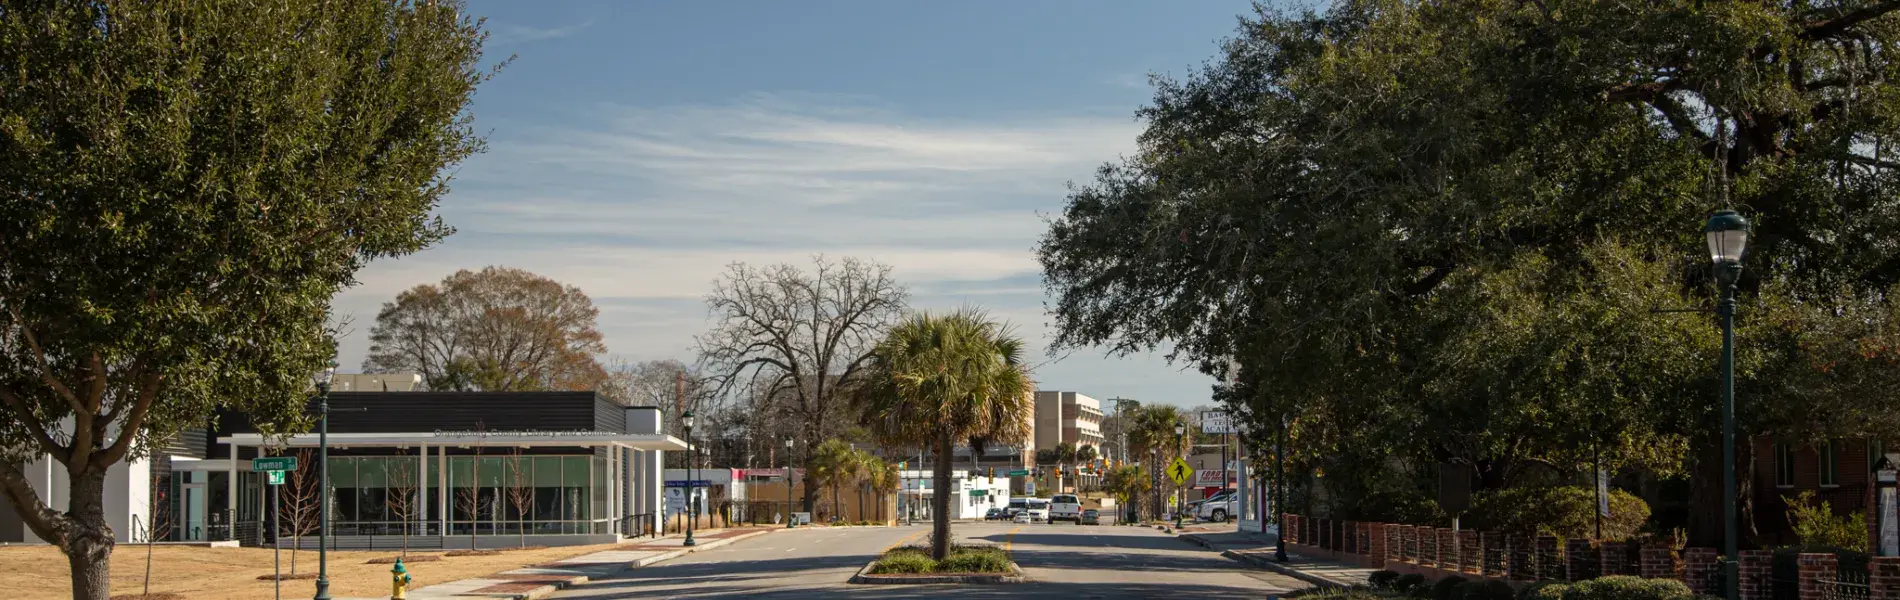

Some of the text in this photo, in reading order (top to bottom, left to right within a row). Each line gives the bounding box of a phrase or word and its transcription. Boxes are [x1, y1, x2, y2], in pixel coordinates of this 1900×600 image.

[434, 428, 487, 438] Orangeburg
[491, 428, 522, 438] County
[526, 428, 556, 438] Library
[560, 428, 578, 437] and
[254, 460, 283, 470] Lowman
